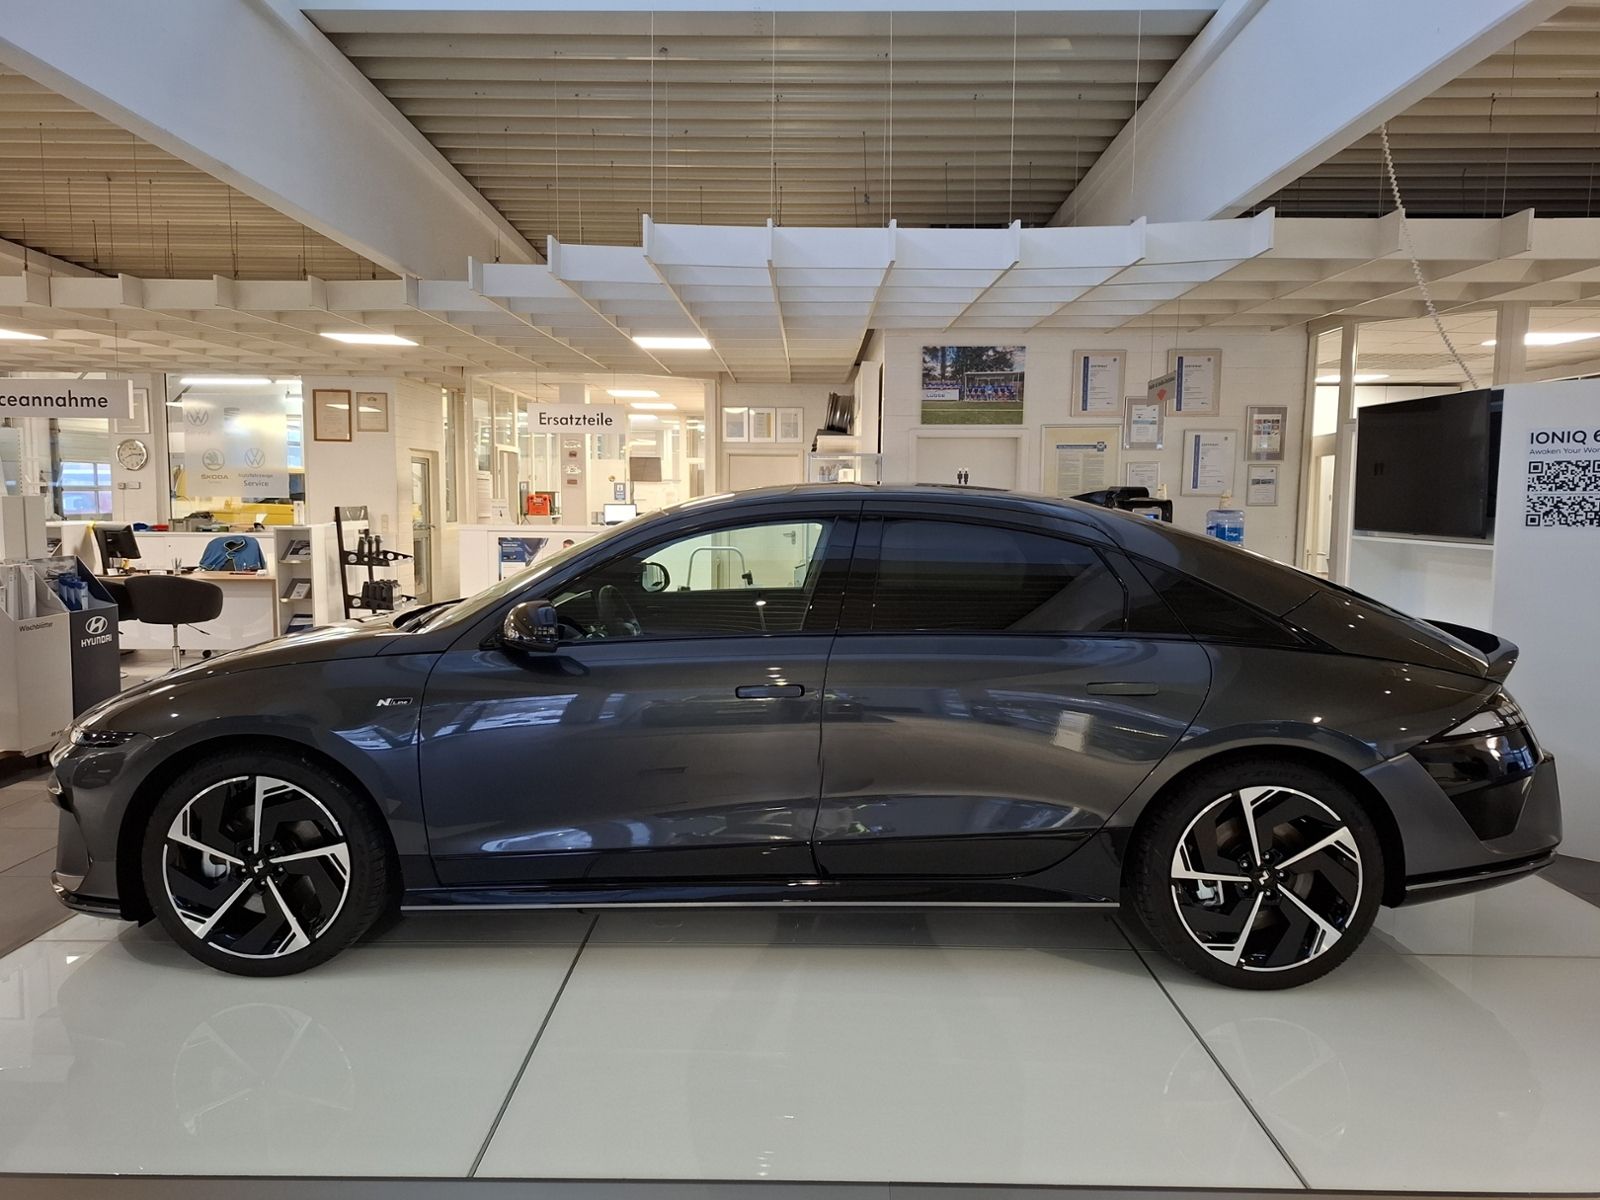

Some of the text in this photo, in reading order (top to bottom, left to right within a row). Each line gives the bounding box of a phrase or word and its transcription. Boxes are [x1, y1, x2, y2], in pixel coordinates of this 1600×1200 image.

[539, 411, 613, 426] Ersatzteile
[1530, 430, 1587, 445] IONIQ
[243, 480, 270, 488] Service
[81, 634, 112, 647] HYUNDAI
[376, 698, 391, 706] N
